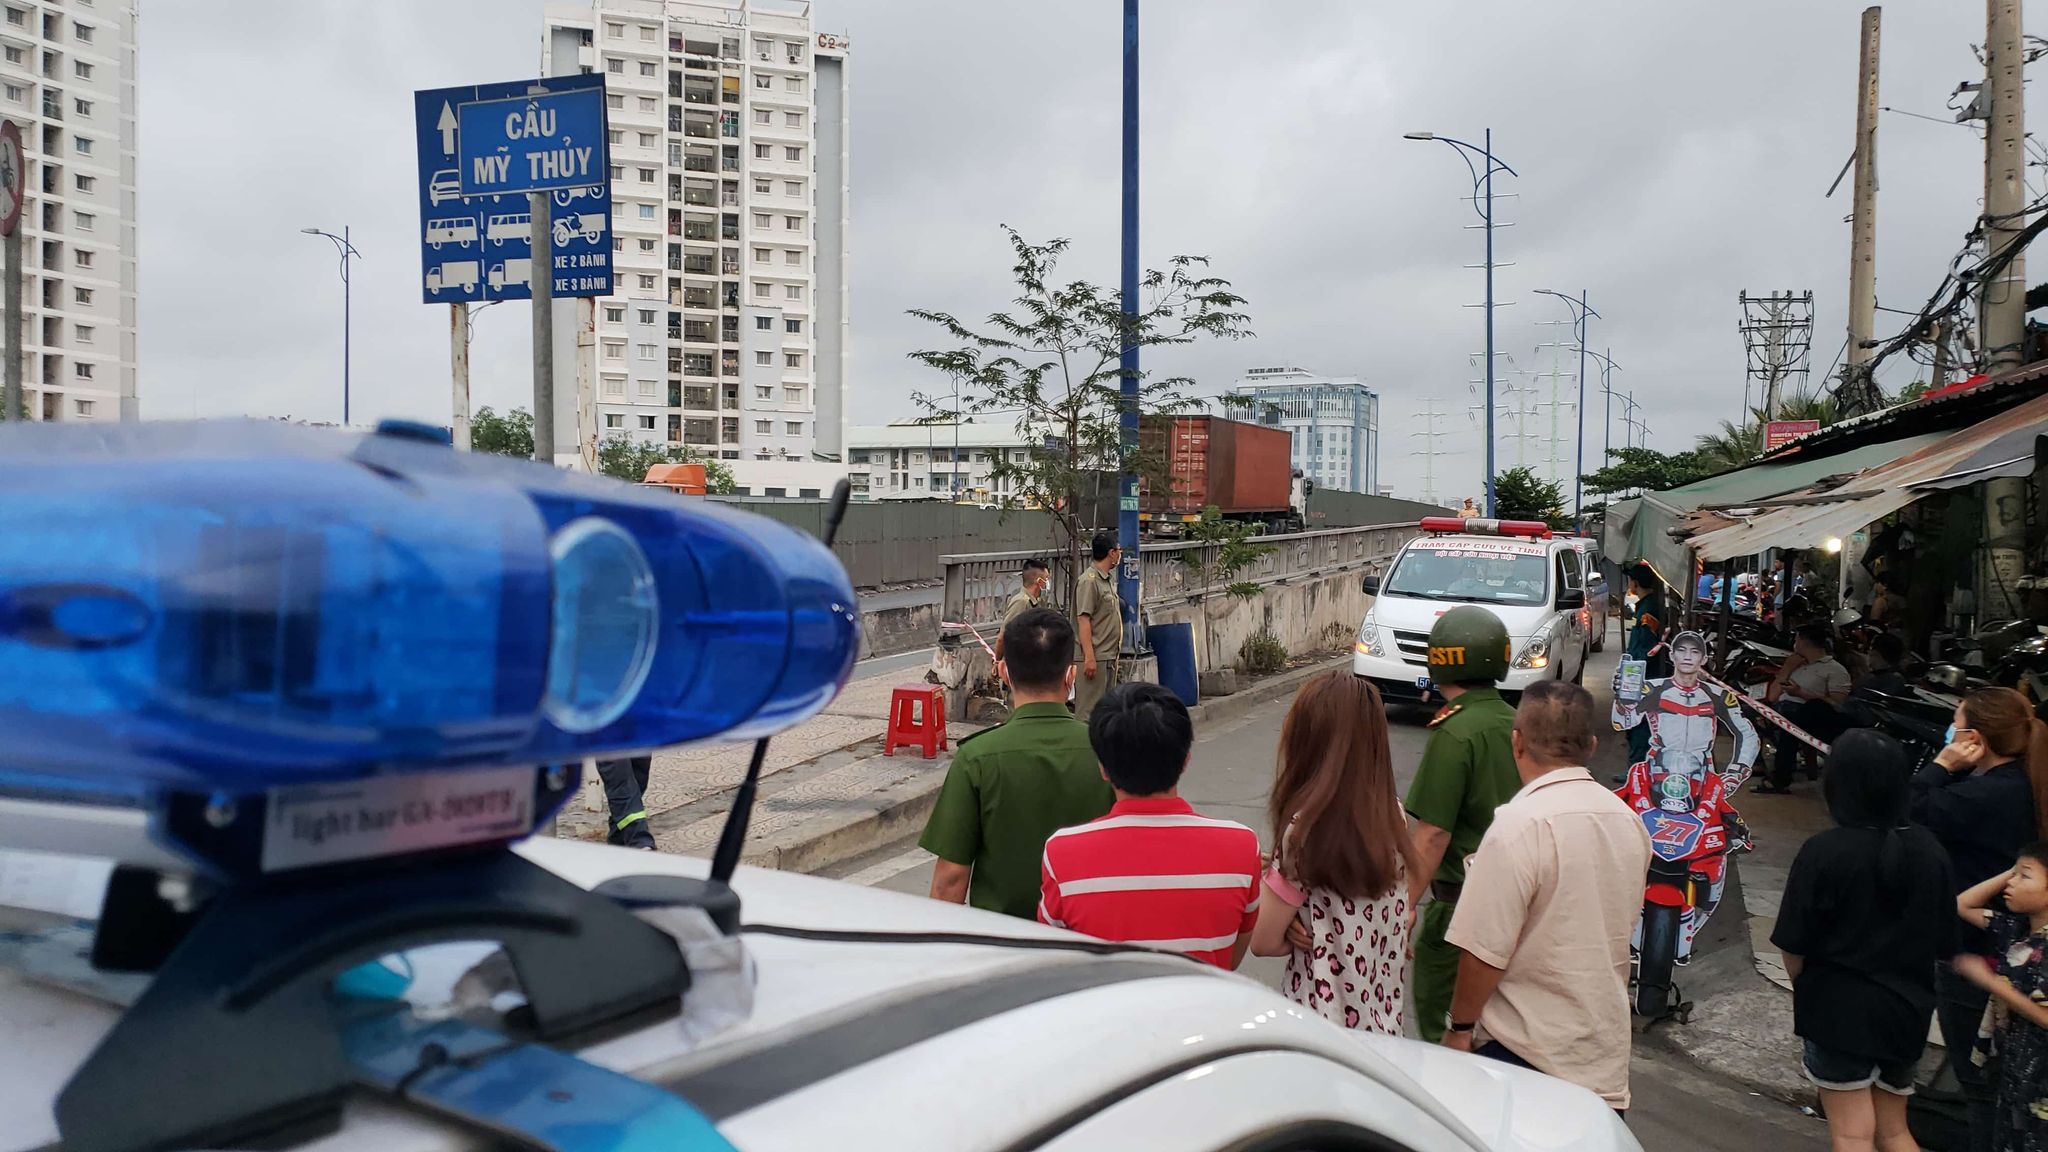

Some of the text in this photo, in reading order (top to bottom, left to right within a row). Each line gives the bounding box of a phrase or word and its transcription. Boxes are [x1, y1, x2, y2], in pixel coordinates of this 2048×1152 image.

[506, 100, 557, 140] CẦU
[473, 136, 592, 185] MỸ THỦY
[554, 251, 606, 269] XE 2 BÀNH
[555, 278, 569, 291] XE
[580, 274, 607, 290] BÀNH
[1429, 646, 1466, 666] CSTT
[1651, 819, 1699, 847] 27
